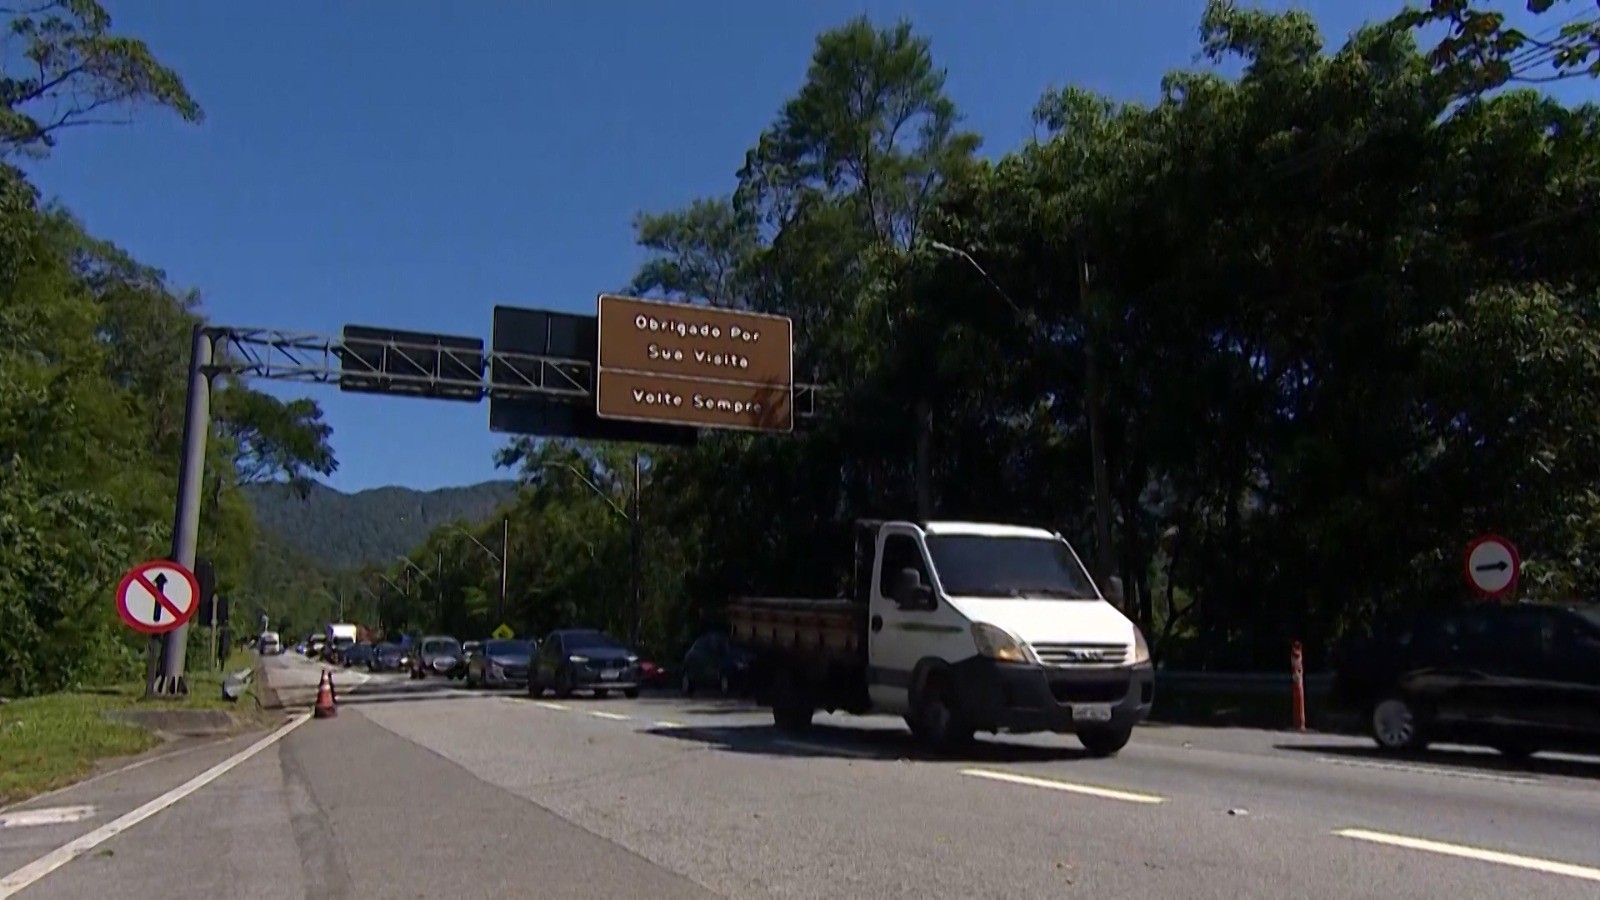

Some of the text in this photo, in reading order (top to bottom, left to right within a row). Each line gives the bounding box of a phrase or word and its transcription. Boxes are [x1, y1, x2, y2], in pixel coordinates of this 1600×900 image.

[635, 314, 761, 342] Obrigado Por
[648, 344, 748, 368] Sua Visita
[632, 389, 761, 413] Volte Sempre
